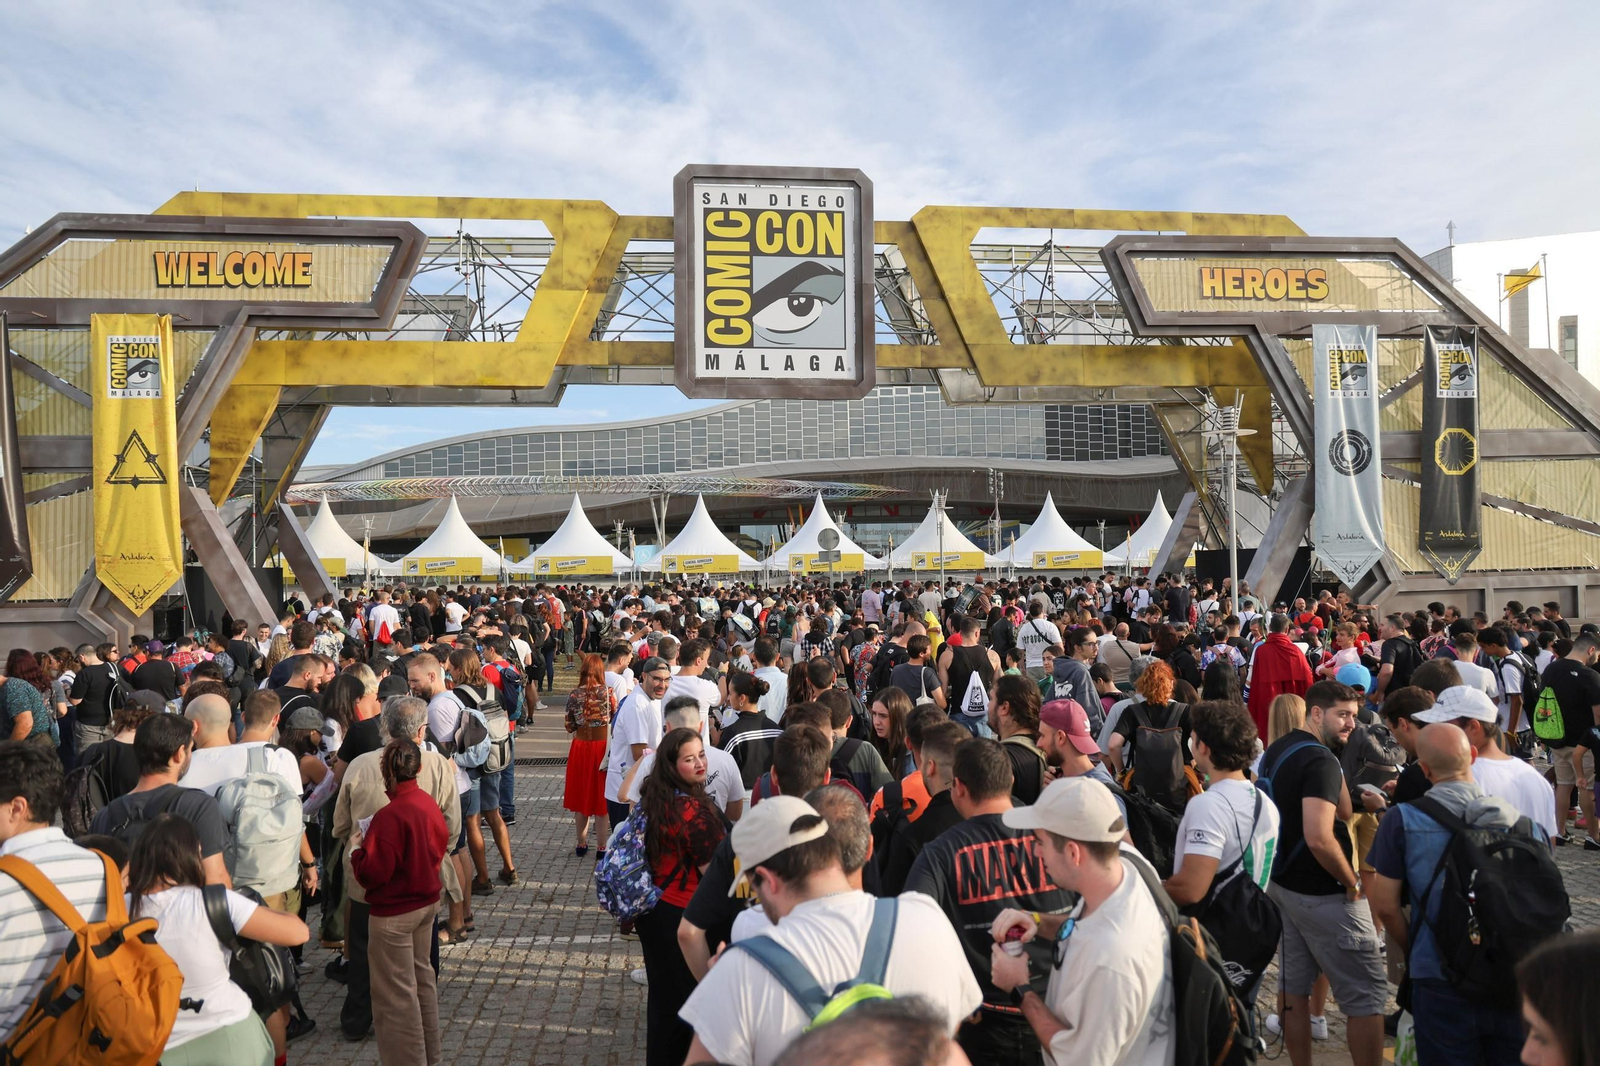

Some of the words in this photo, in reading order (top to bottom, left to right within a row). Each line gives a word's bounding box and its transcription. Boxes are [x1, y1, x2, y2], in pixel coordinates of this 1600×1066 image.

[702, 192, 747, 206] SAN
[769, 194, 845, 208] DIEGO
[755, 210, 843, 256] CON
[153, 251, 312, 287] WELCOME
[705, 210, 751, 346] COMIC
[1201, 267, 1329, 300] HEROES
[111, 343, 128, 388] COMIC
[128, 343, 159, 358] CON
[705, 350, 845, 372] MÁLAGA
[1342, 350, 1367, 363] CON
[1330, 350, 1341, 390] COMIC
[1439, 351, 1451, 389] COMIC
[957, 838, 1056, 902] MARV
